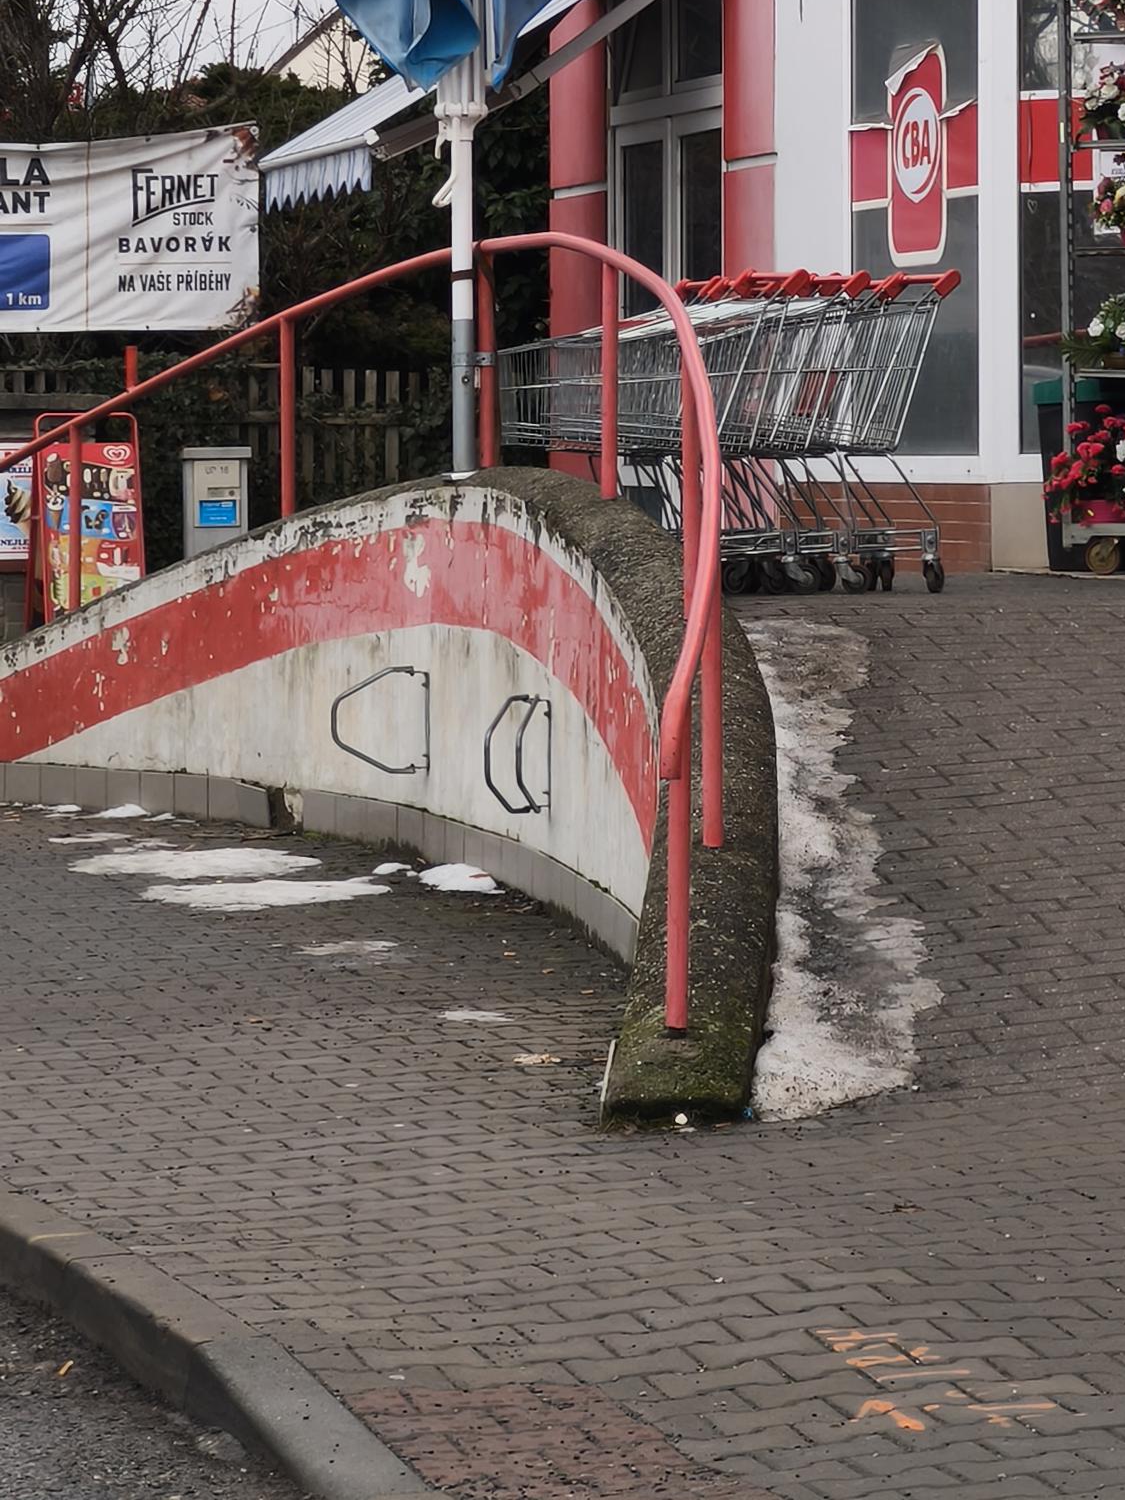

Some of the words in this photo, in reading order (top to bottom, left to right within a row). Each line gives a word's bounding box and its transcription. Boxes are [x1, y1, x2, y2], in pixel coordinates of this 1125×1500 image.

[902, 119, 931, 169] CBA
[131, 168, 219, 221] FERNET
[173, 211, 214, 226] STOCK
[118, 231, 232, 253] BAVORÁK
[118, 275, 136, 292] NA
[140, 270, 172, 292] VAŠE
[176, 269, 231, 291] PŘÍBĚHY
[6, 292, 13, 305] 1
[18, 292, 42, 305] km
